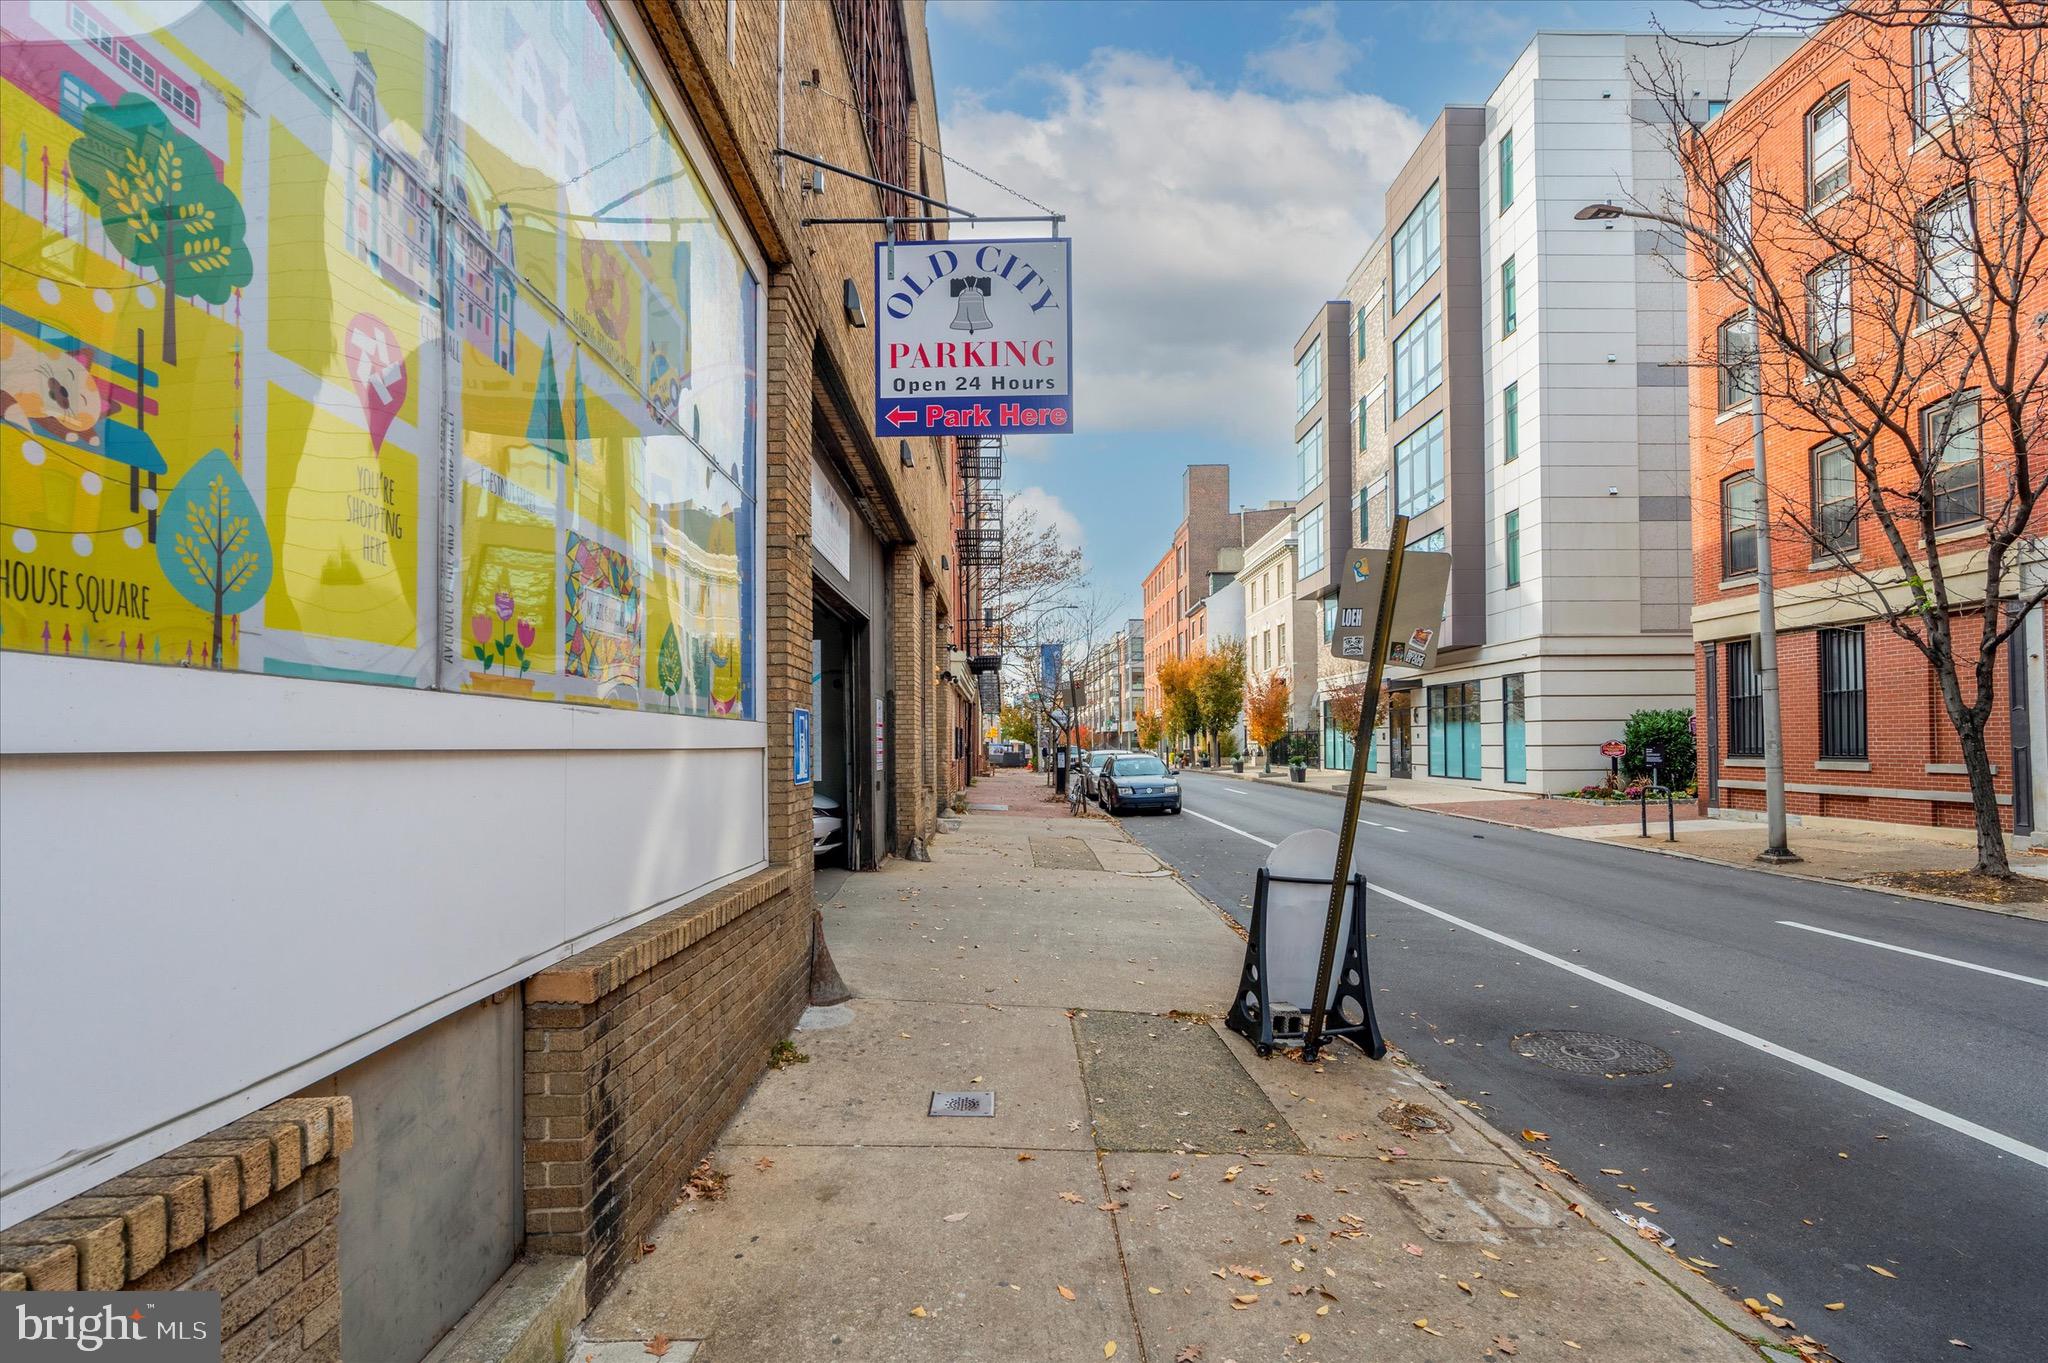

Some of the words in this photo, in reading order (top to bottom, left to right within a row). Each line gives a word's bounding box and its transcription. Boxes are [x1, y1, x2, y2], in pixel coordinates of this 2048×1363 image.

[887, 250, 958, 319] OLD
[976, 245, 1060, 315] CITY
[888, 339, 1055, 369] PARKING
[893, 377, 946, 394] Open
[955, 376, 981, 391] 24
[991, 376, 1055, 390] Hours
[925, 404, 991, 427] Park
[1000, 403, 1067, 426] Here
[357, 466, 395, 506] YOU'RE
[346, 495, 403, 539] SHOPPING
[363, 533, 387, 567] HERE
[75, 572, 150, 623] SQUARE
